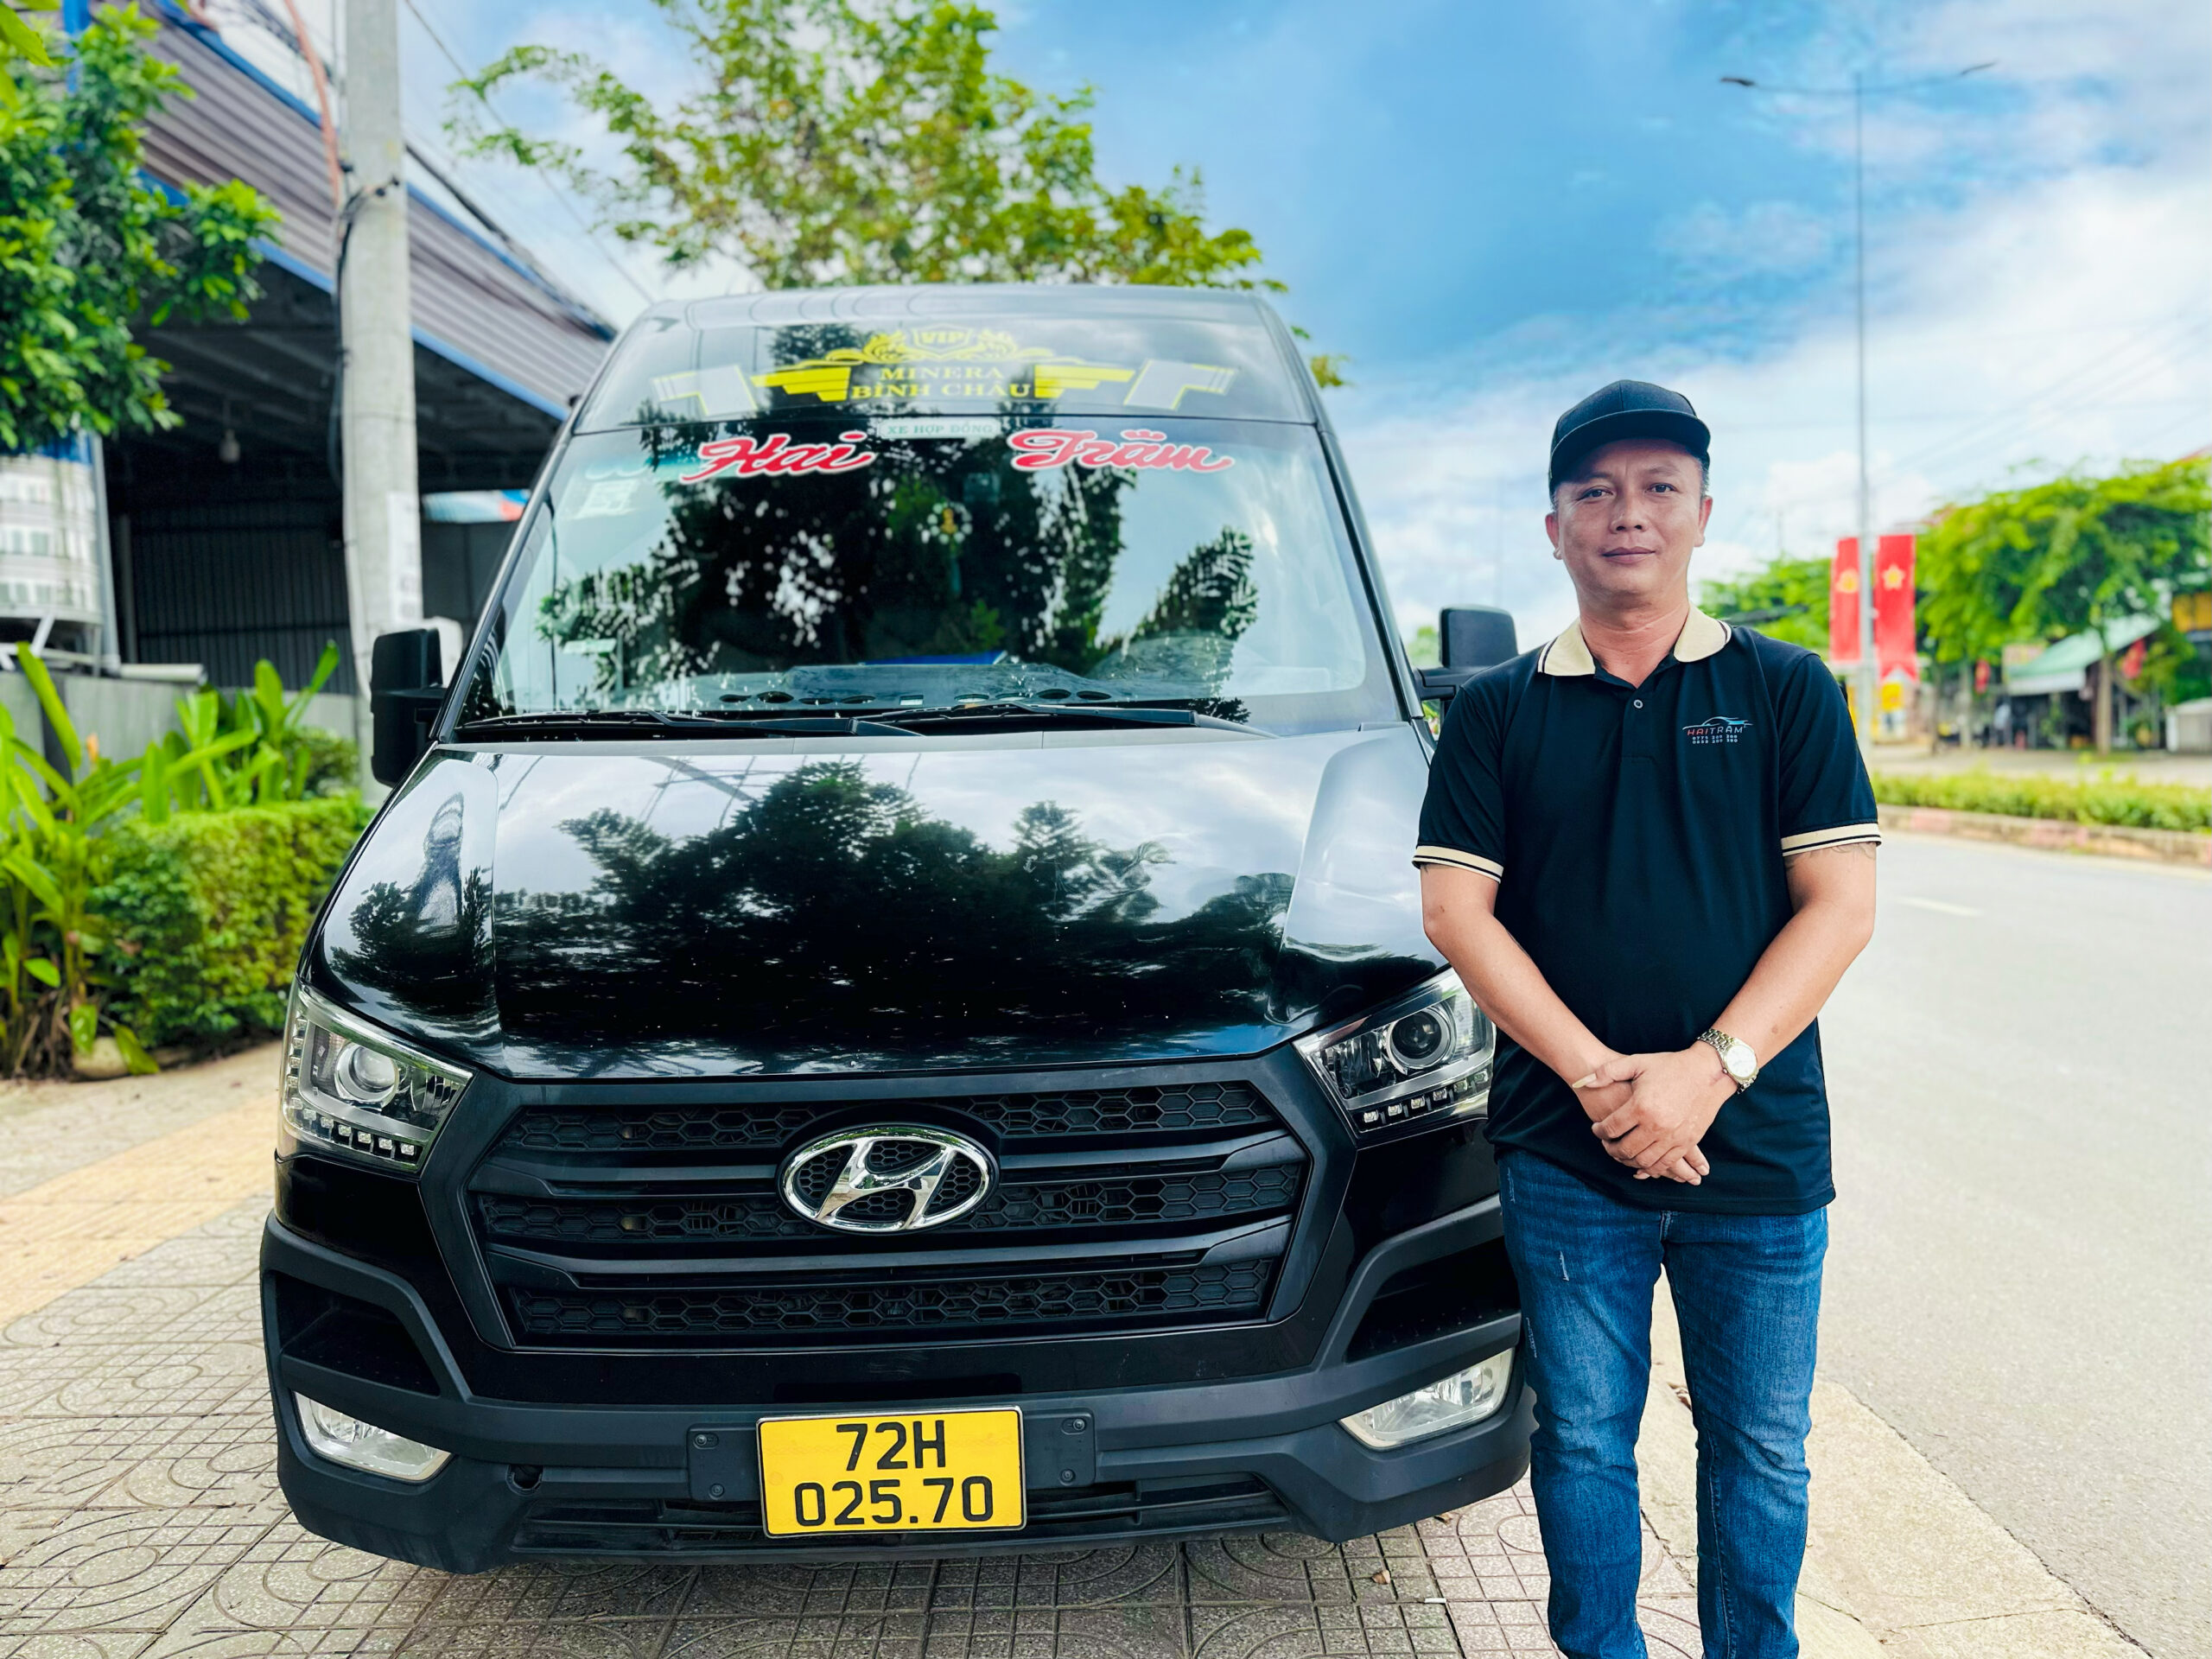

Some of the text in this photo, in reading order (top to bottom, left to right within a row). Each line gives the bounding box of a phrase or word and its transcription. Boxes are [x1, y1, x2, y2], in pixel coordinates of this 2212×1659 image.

[921, 331, 964, 343] VIP
[880, 366, 1004, 380] MINERA
[850, 379, 1031, 399] BÌNH CHÂU
[887, 424, 908, 435] XE
[679, 431, 876, 485] Hai
[836, 1420, 946, 1471] 72H
[793, 1475, 994, 1527] 025.70
